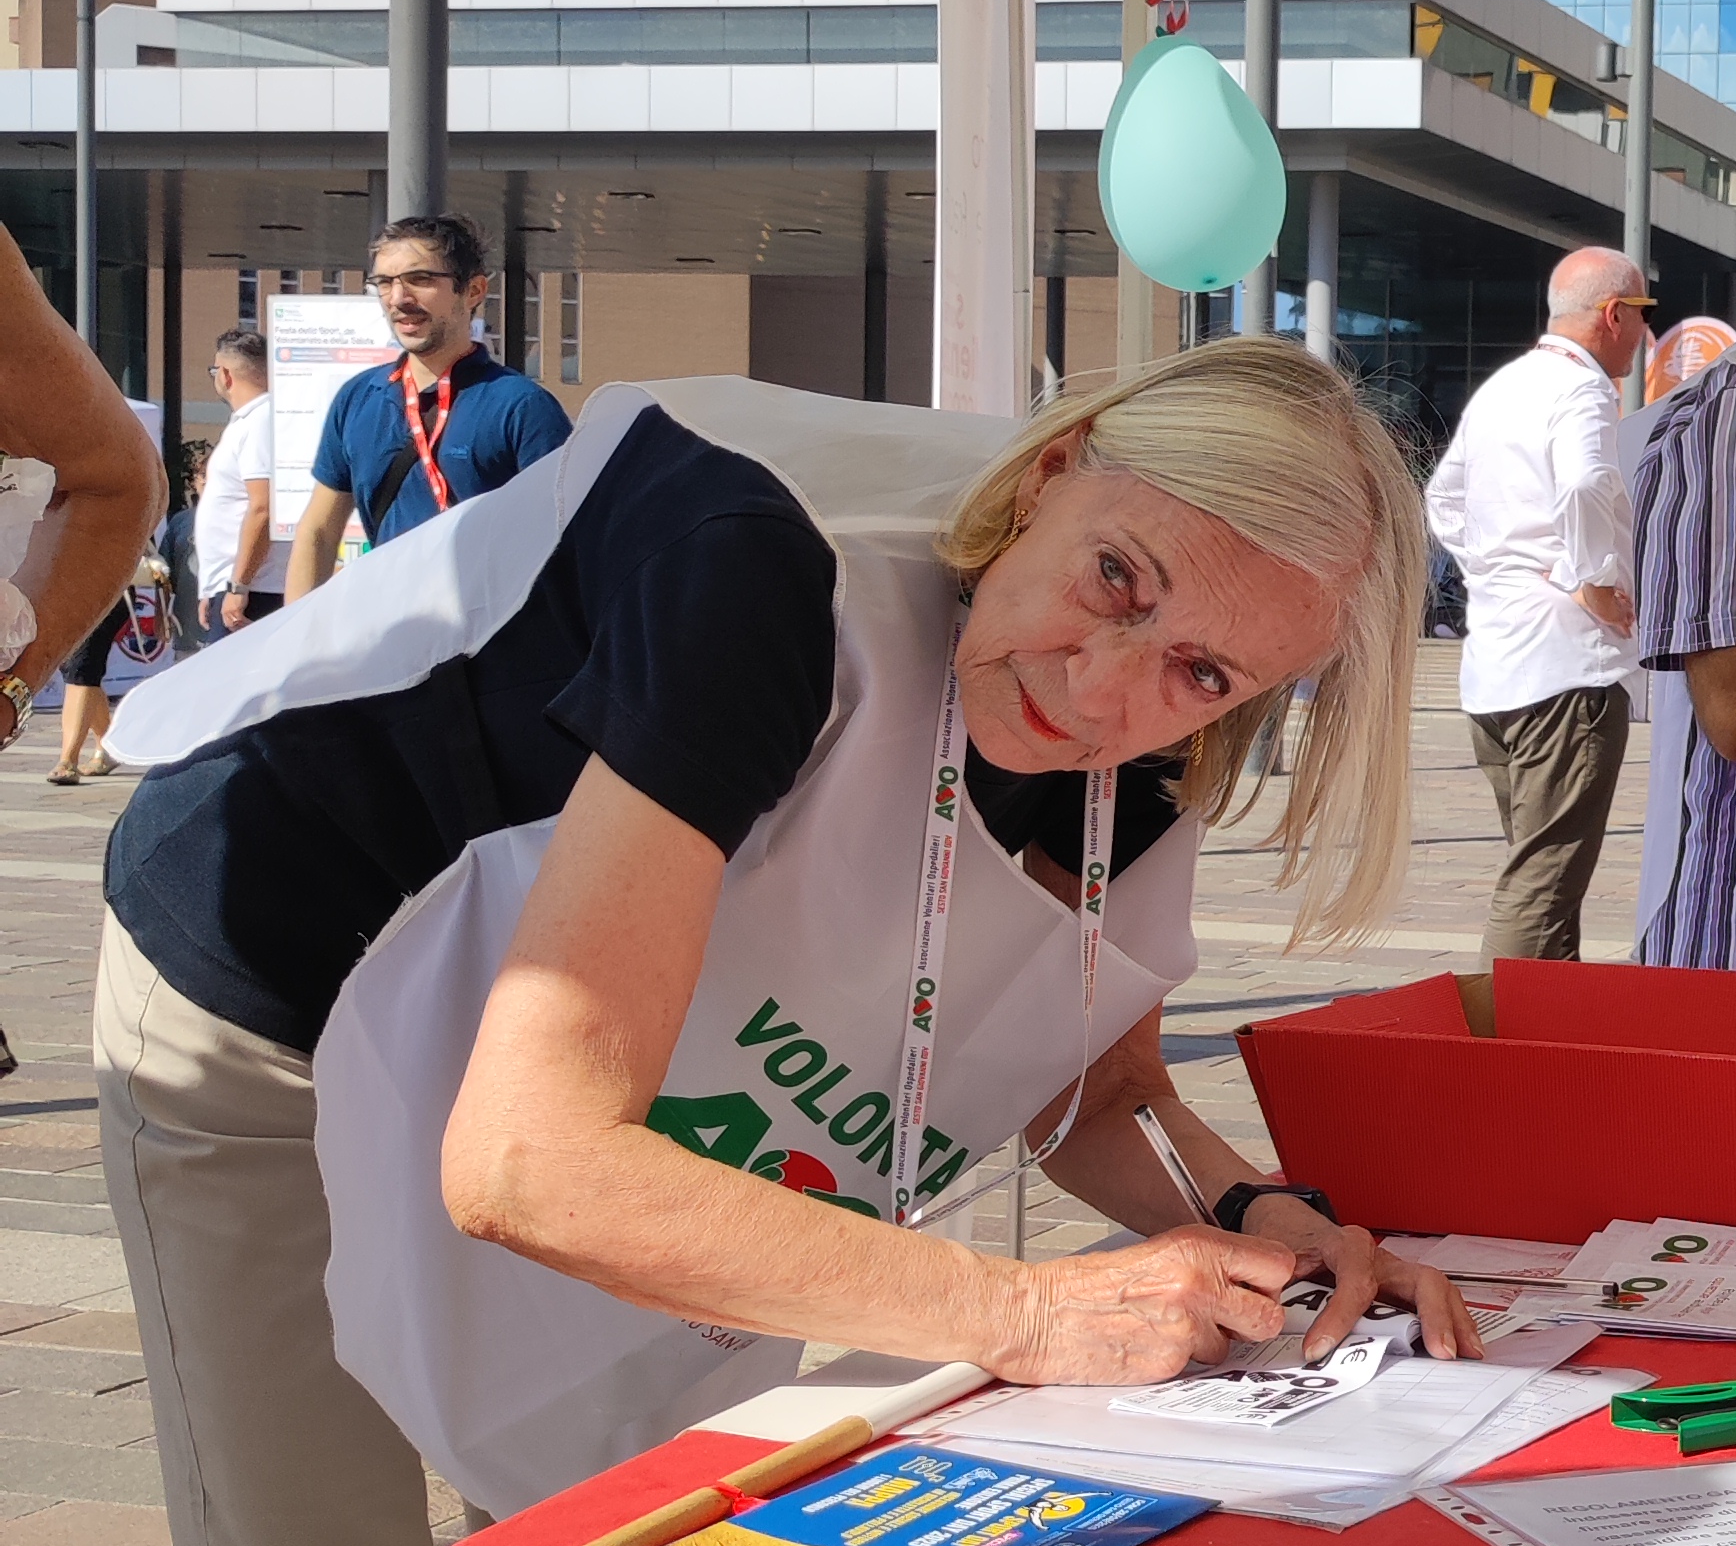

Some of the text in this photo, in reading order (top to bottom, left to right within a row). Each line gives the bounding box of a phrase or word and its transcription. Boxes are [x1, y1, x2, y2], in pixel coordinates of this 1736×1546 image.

[917, 835, 941, 972] Associazione Volontari Ospedalieri
[896, 1046, 918, 1181] Associazione Volontari Ospedalieri
[1542, 1493, 1703, 1514] REGOLAMENTO
[1655, 1512, 1714, 1524] orario
